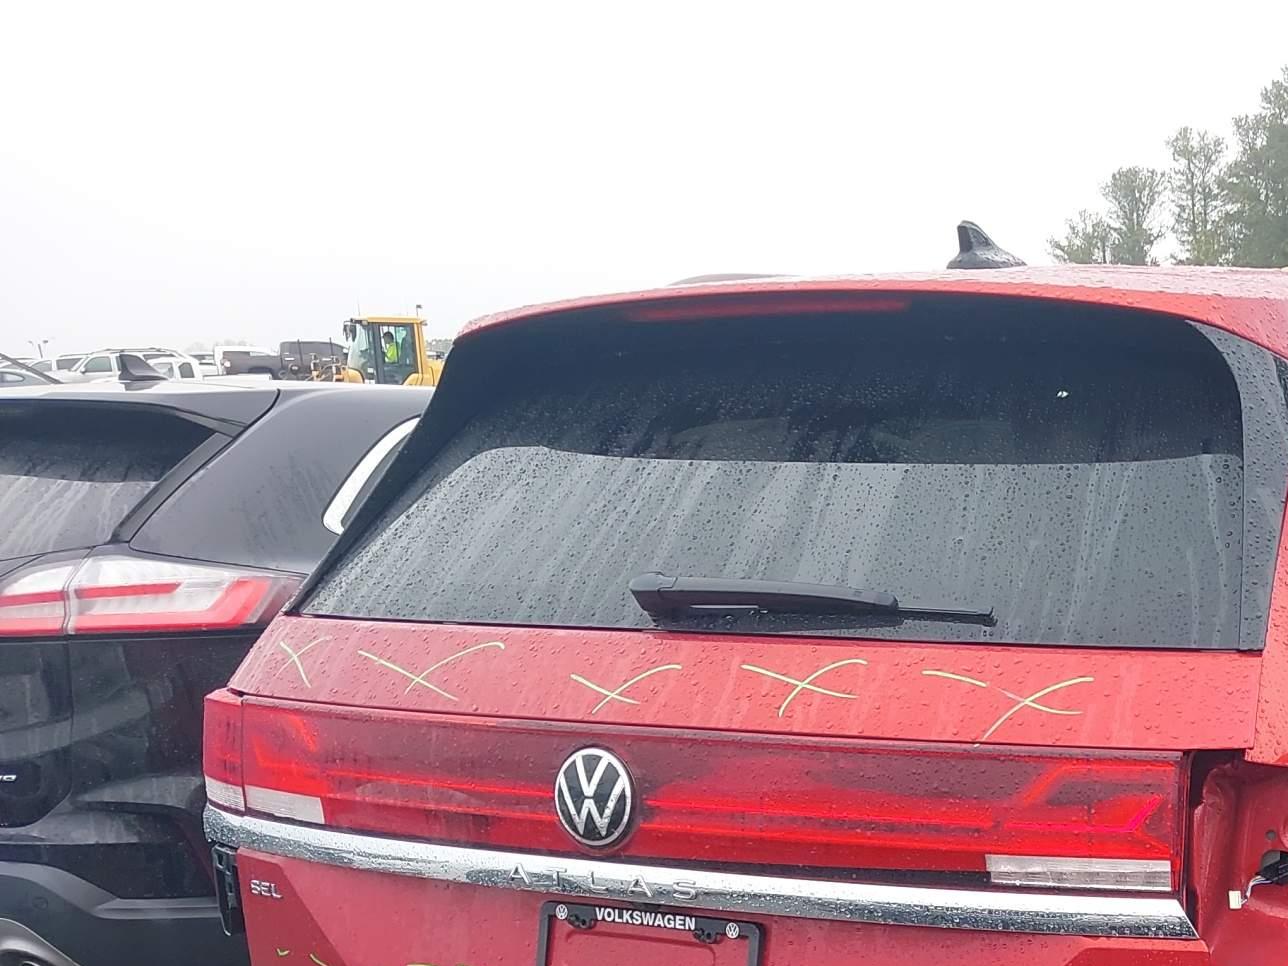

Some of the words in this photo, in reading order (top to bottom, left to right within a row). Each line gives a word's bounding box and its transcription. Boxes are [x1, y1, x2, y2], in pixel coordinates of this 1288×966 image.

[250, 879, 283, 899] SEL
[508, 863, 698, 900] ATLAS
[595, 907, 696, 930] VOLKSWAGEN
